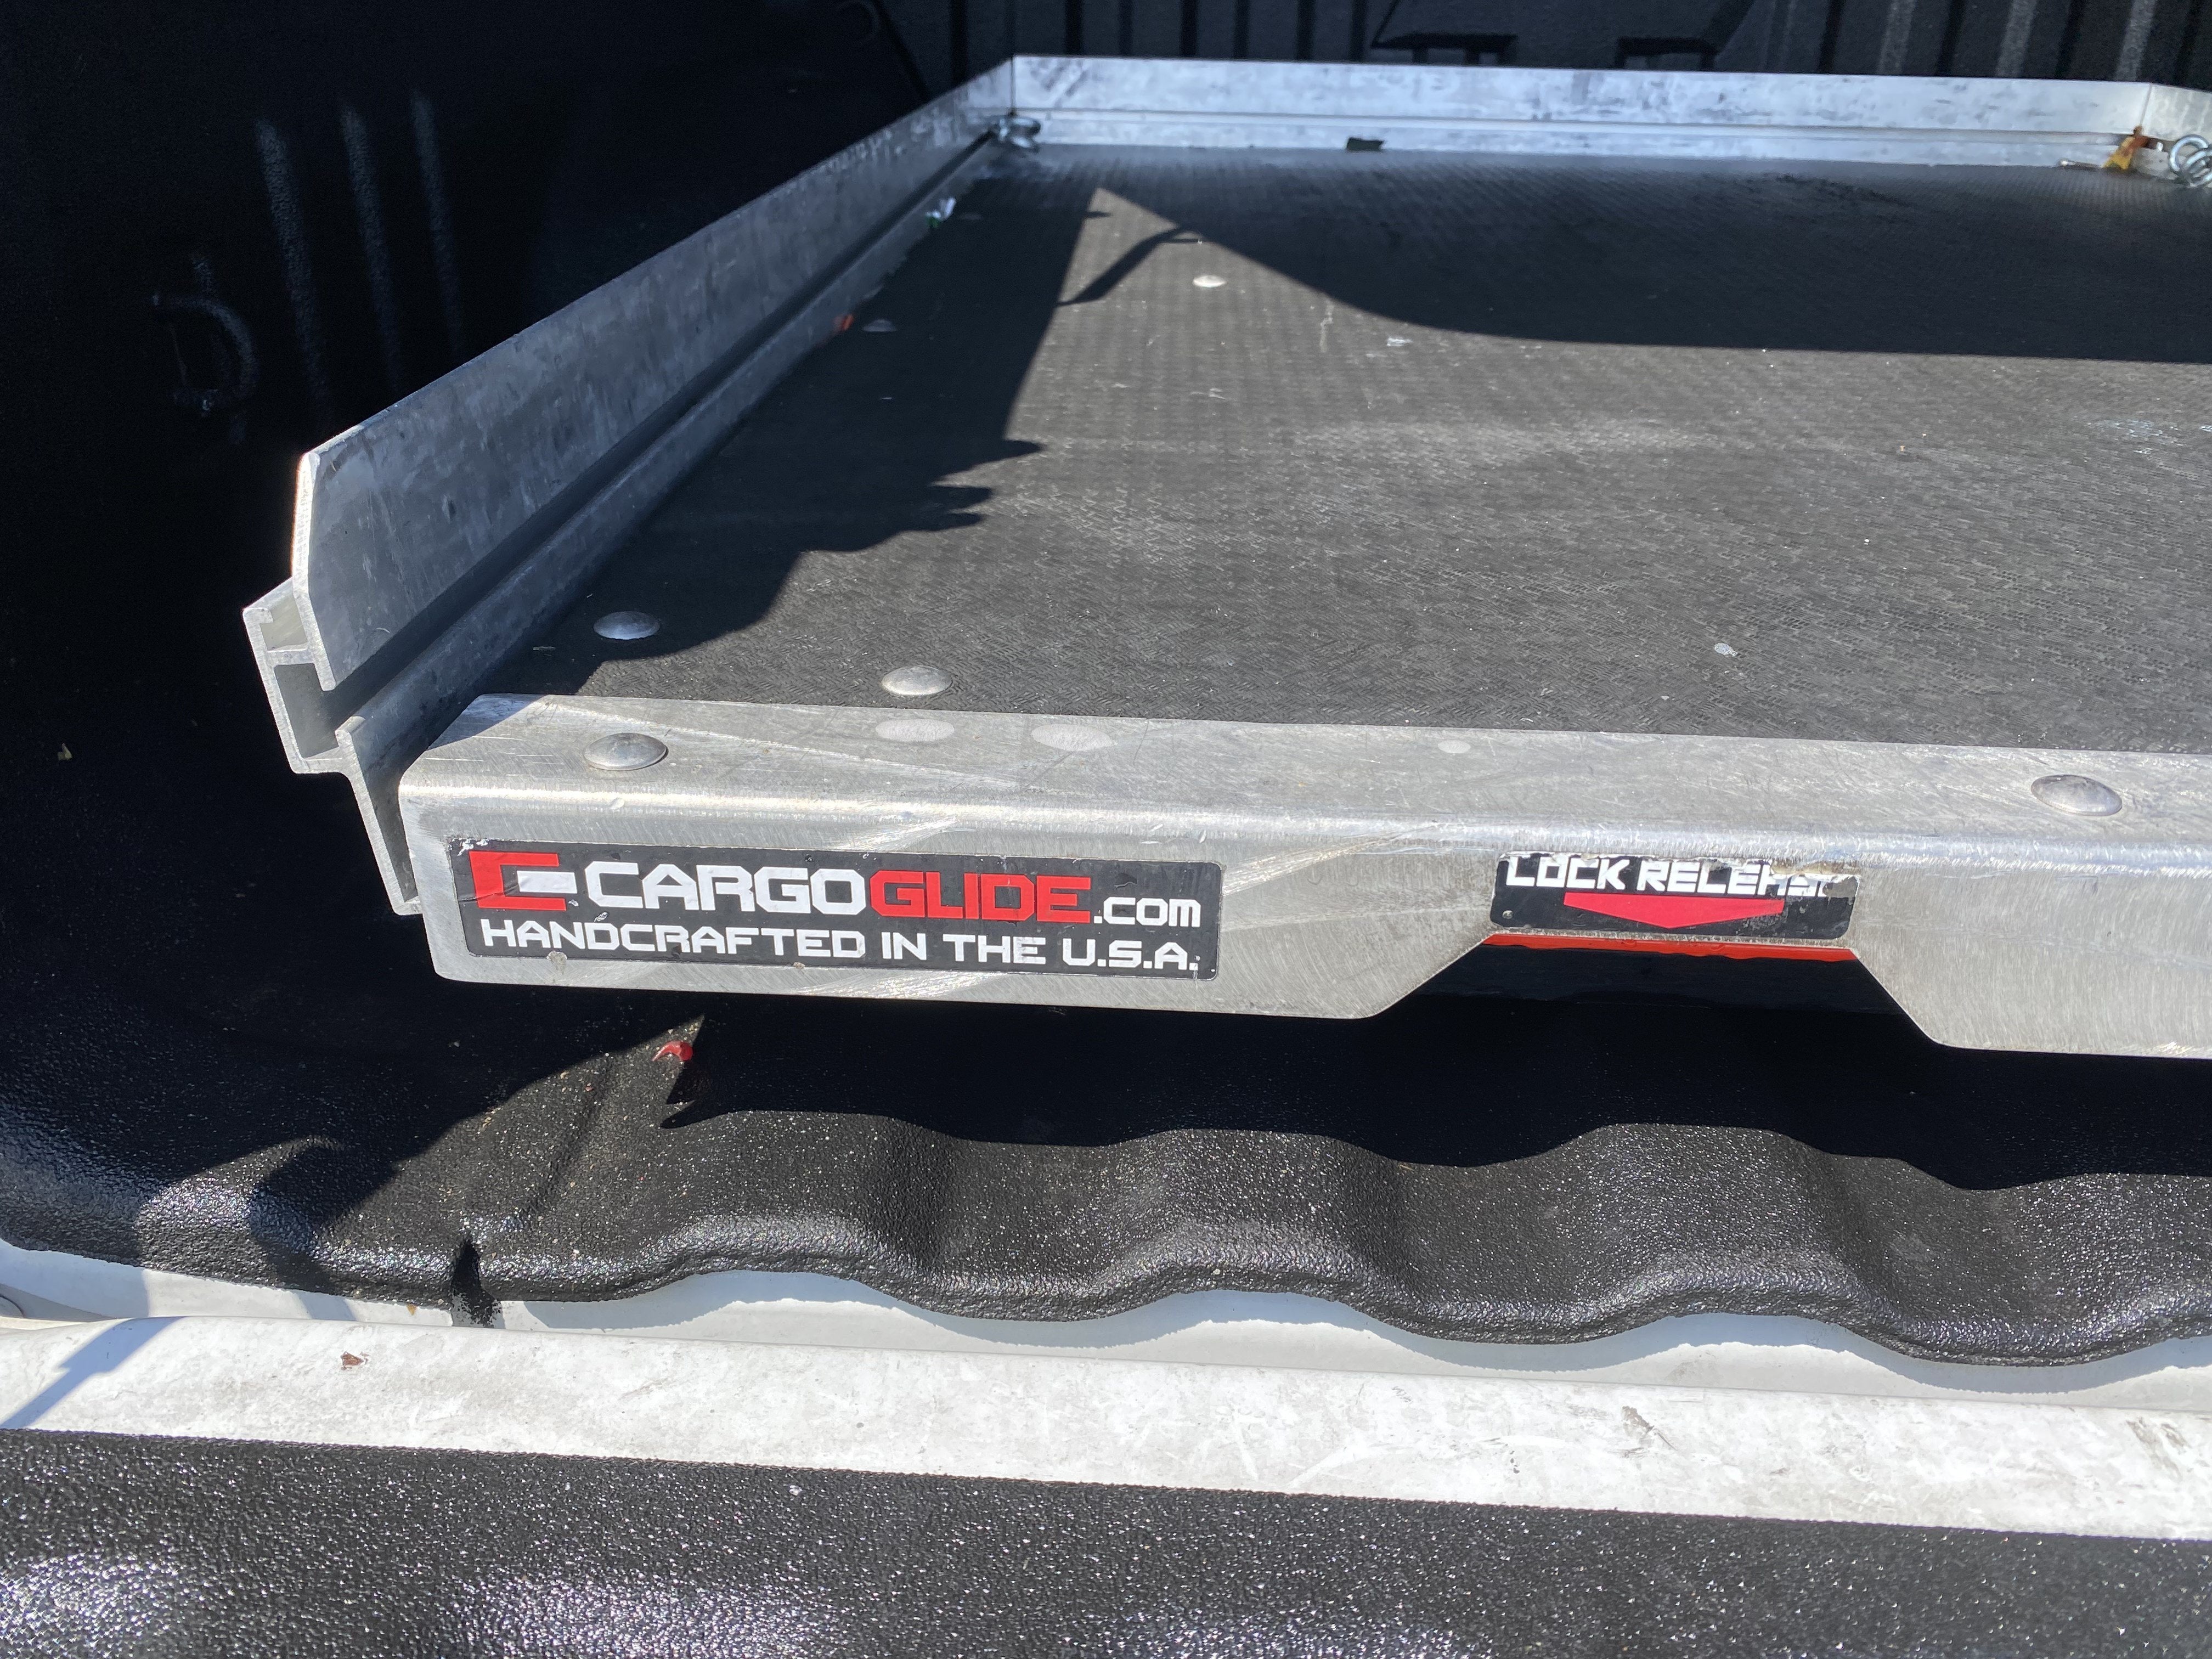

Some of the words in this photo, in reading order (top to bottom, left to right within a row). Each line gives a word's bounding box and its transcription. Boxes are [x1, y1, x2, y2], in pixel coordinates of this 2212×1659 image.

[1506, 856, 1630, 890] LOCK
[481, 919, 865, 958] HANDCRAFTED
[882, 932, 927, 961] IN
[943, 934, 1046, 964] THE
[1062, 938, 1200, 970] U.S.A.
